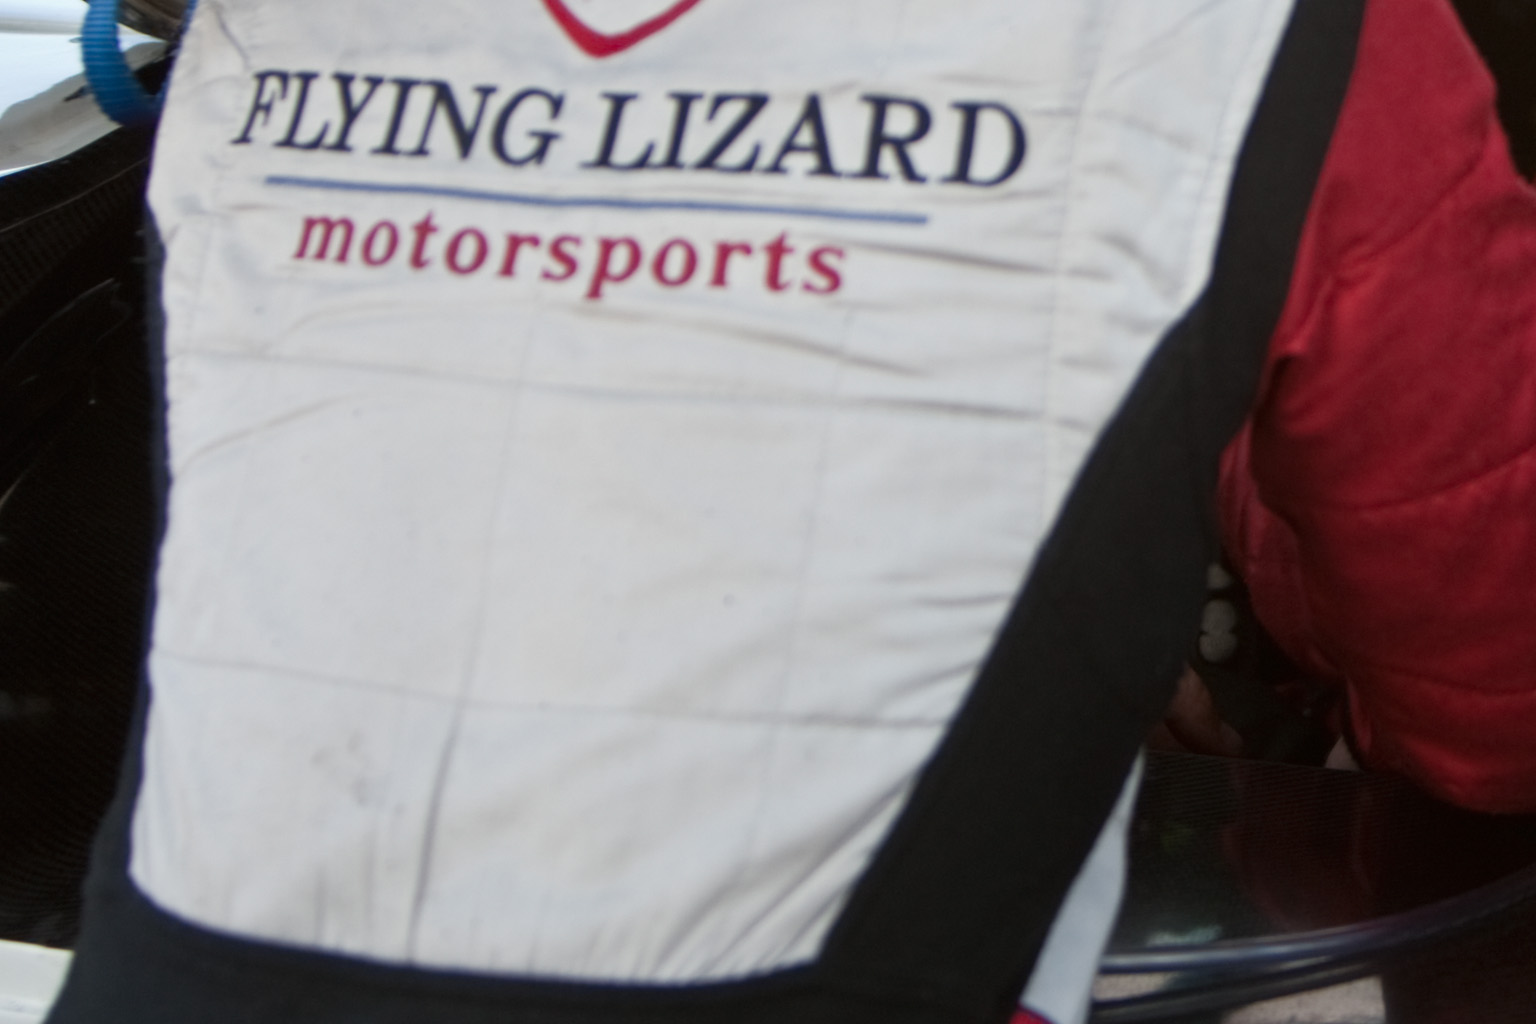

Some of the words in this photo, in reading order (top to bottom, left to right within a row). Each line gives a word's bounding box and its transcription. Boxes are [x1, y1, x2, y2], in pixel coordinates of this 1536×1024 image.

[232, 70, 564, 167] FLYING
[581, 92, 1028, 187] LIZARD
[293, 211, 847, 300] motorsports
